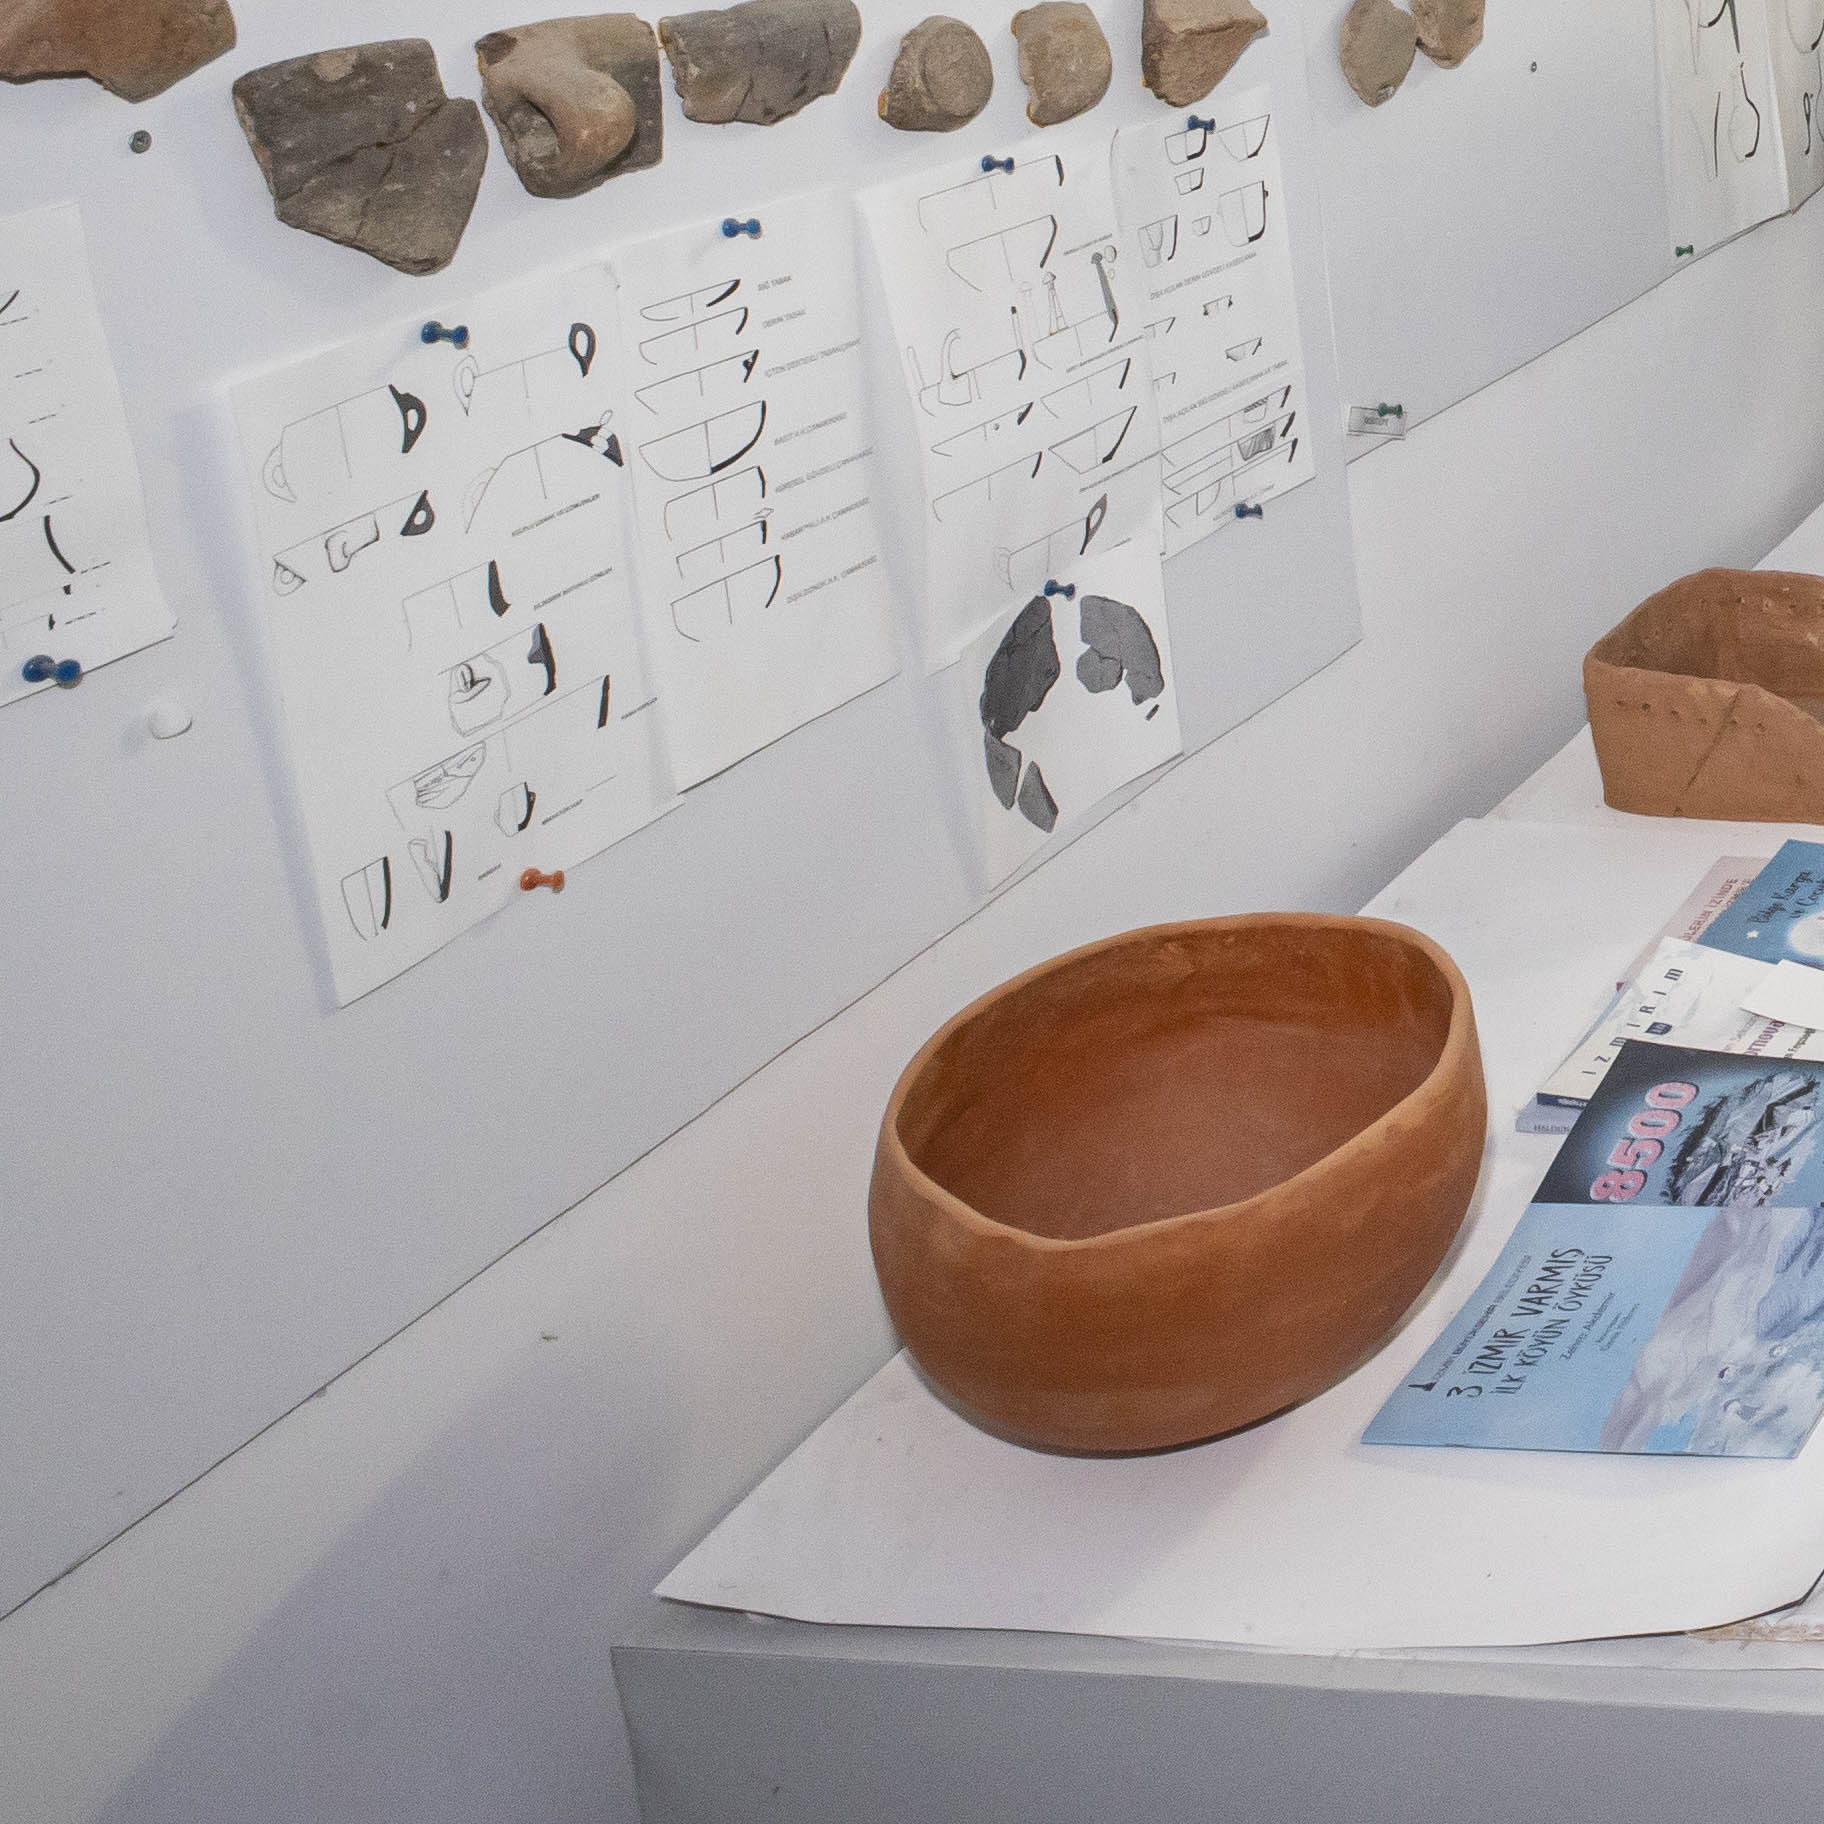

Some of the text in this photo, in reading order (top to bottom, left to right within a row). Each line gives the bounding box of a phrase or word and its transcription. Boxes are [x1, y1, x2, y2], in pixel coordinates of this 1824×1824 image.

[1771, 871, 1813, 901] Karga
[1589, 1081, 1700, 1203] 8500
[1446, 1247, 1585, 1399] 3 İZMİR VARMIŞ
[1489, 1374, 1526, 1395] İLK
[1513, 1318, 1571, 1367] KÖYÜN
[1552, 1254, 1614, 1312] ÖYKÜSÜ
